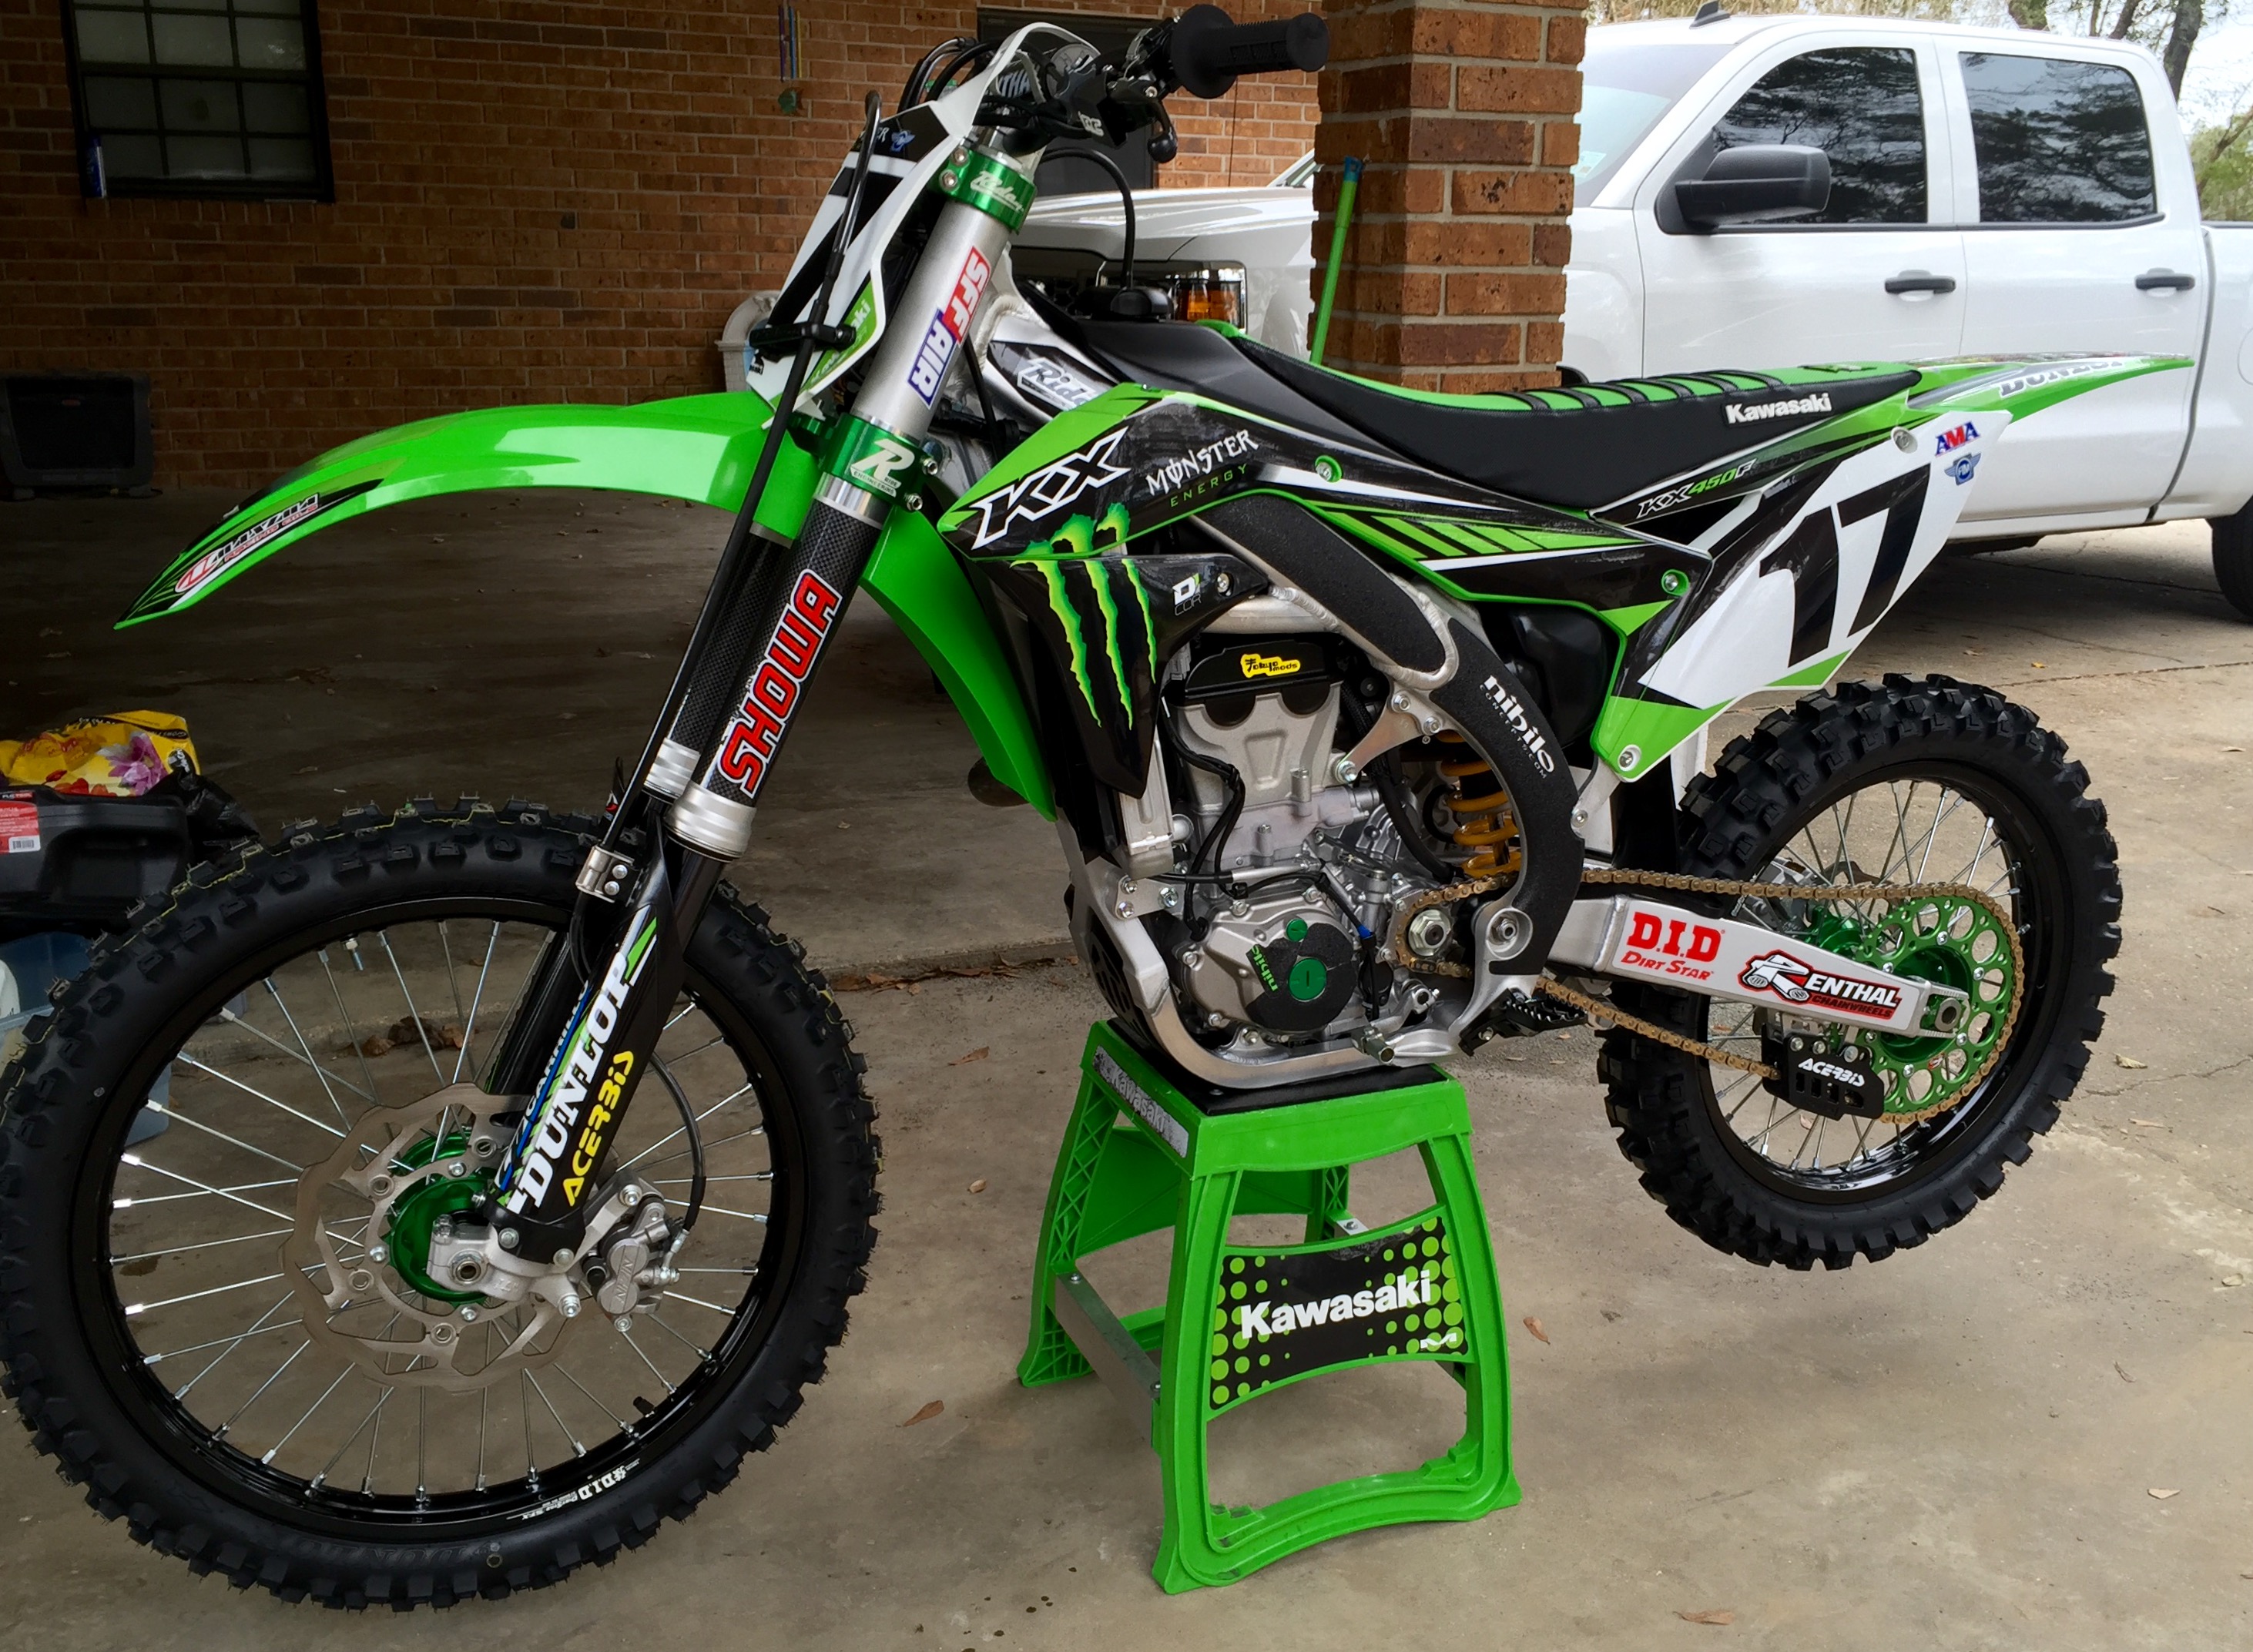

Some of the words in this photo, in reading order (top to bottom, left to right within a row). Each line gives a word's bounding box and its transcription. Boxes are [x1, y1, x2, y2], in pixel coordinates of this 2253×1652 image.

[951, 253, 991, 337] SFF
[911, 319, 954, 398] AIR
[1725, 393, 1832, 424] Kawasaki
[1935, 421, 1980, 456] AMA
[971, 426, 1132, 551] KX
[1145, 428, 1259, 496] MONSTER
[1169, 464, 1248, 508] ENERGY
[1759, 462, 1931, 669] 17
[718, 568, 843, 799] SHOWA
[1484, 675, 1554, 772] nihilo
[1627, 911, 1722, 963] D.I.D
[1742, 953, 1899, 1008] RENTHAL
[1811, 994, 1893, 1018] CHAINWHEELS
[508, 952, 630, 1214] DUNLOP
[1111, 1067, 1165, 1133] Kawasaki
[1241, 1268, 1432, 1340] Kawasaki
